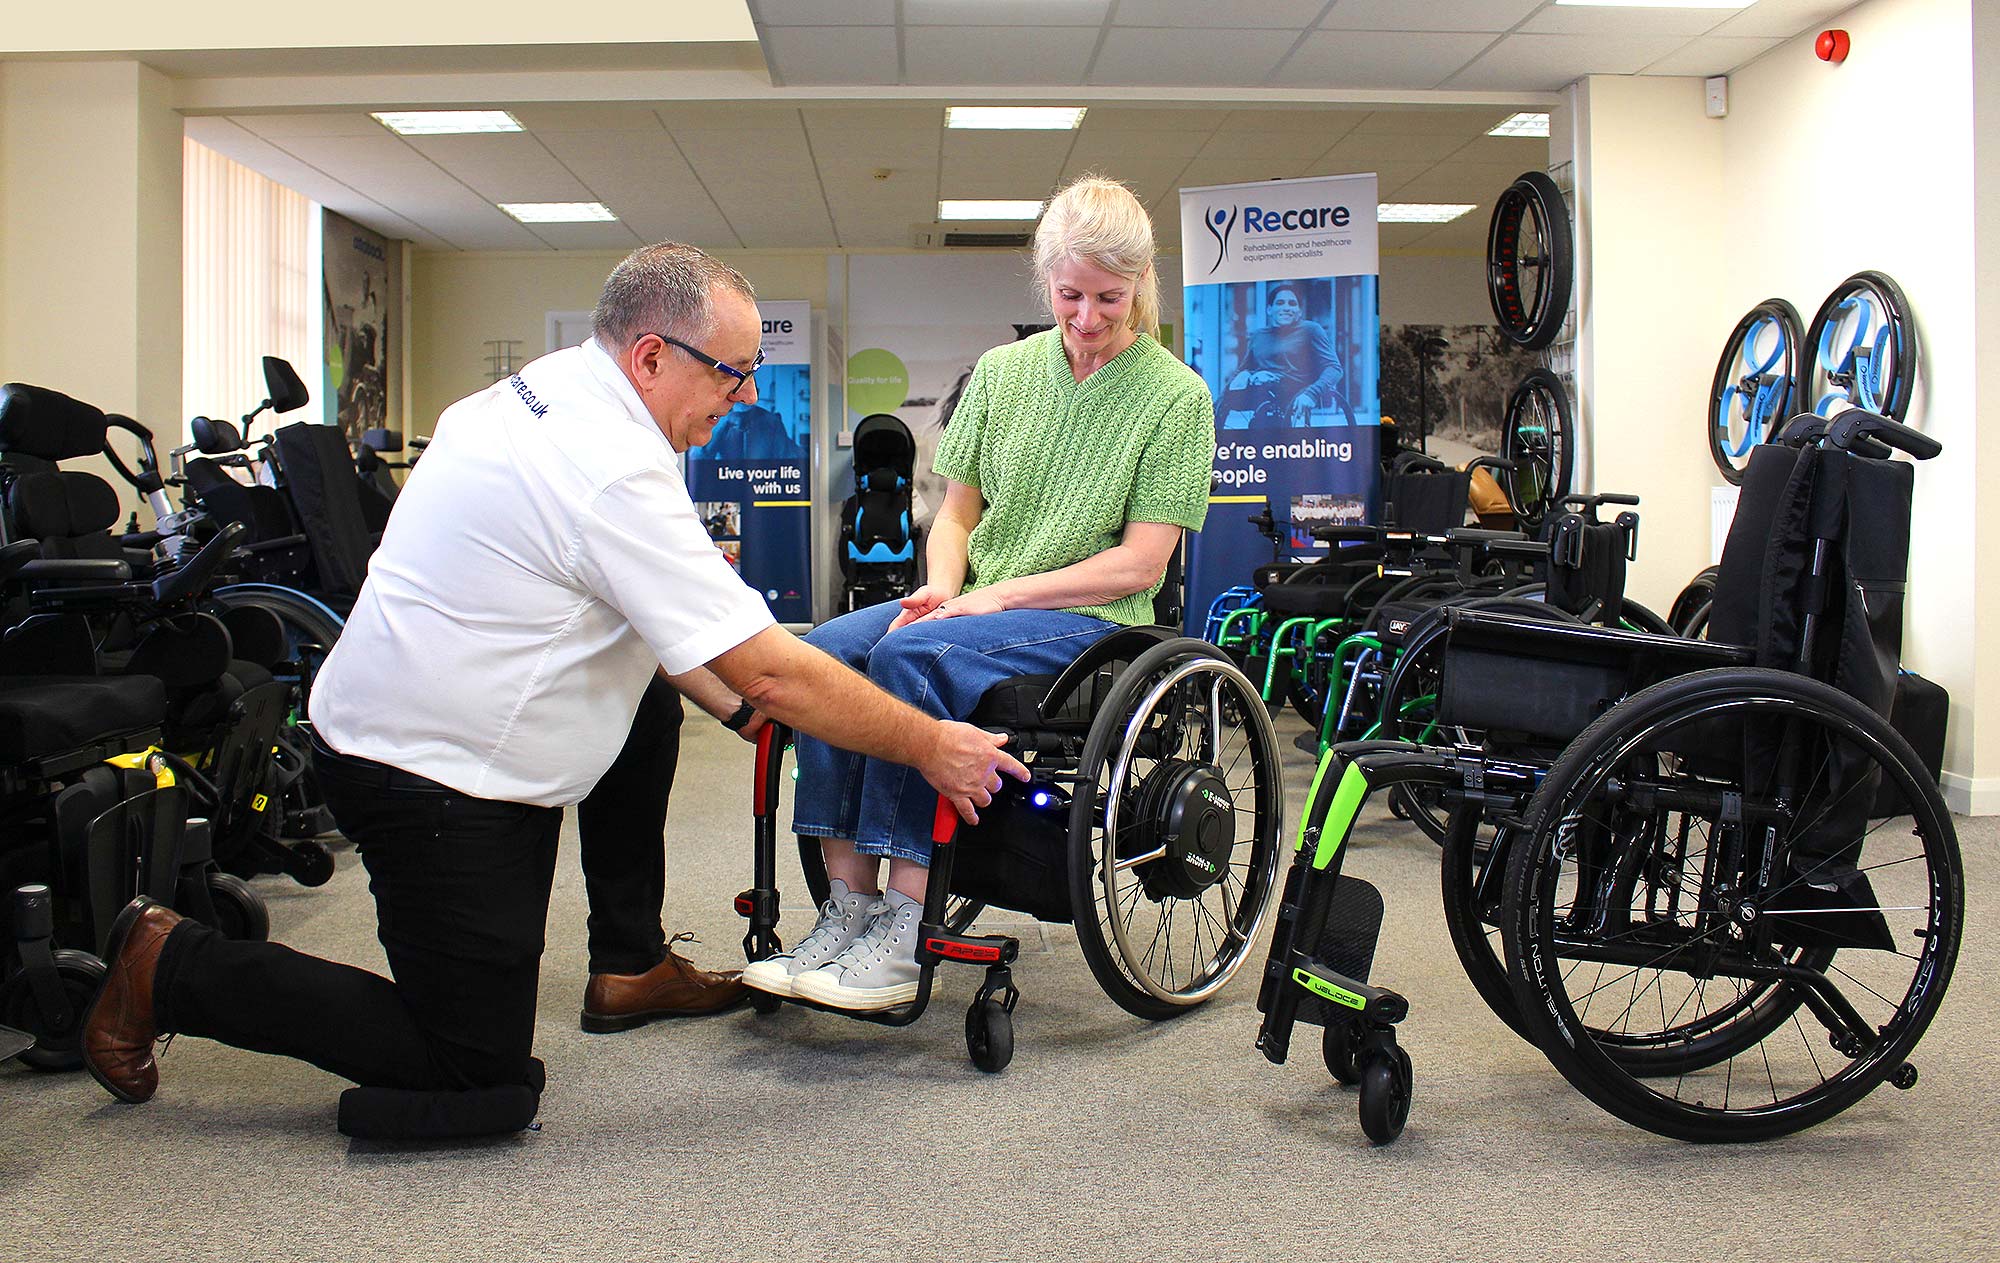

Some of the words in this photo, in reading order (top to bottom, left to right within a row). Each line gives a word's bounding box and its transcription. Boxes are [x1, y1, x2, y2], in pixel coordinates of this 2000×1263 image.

[1243, 206, 1350, 233] Recare
[1243, 243, 1293, 252] Rehabilitation
[1295, 240, 1310, 249] and
[1312, 239, 1352, 248] healthcare
[1243, 252, 1283, 262] equipment
[1285, 249, 1323, 260] specialists
[762, 319, 793, 333] are
[1261, 439, 1352, 462] enabling
[718, 467, 744, 480] Live
[747, 469, 778, 483] your
[780, 466, 801, 479] life
[1211, 464, 1267, 488] eople
[753, 481, 782, 494] with
[785, 484, 801, 494] us
[950, 946, 997, 958] APEX
[1314, 983, 1359, 1006] VELOCE
